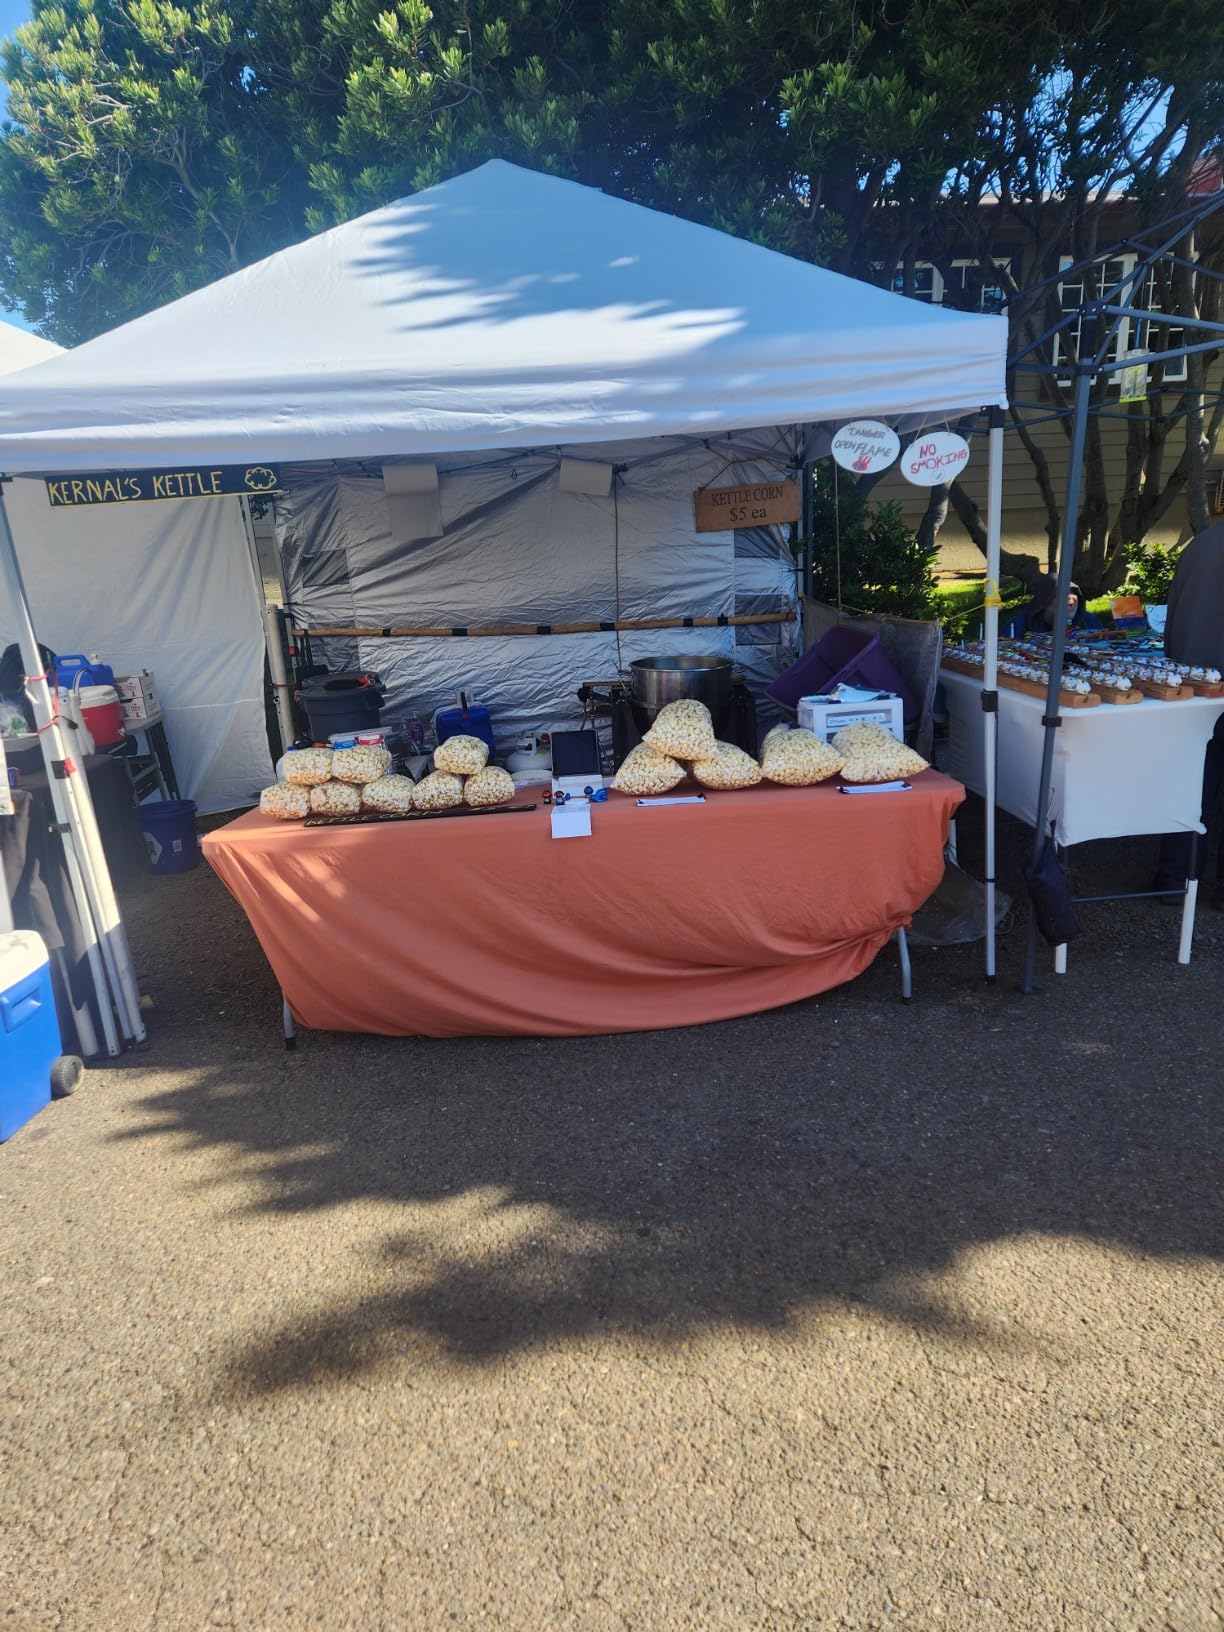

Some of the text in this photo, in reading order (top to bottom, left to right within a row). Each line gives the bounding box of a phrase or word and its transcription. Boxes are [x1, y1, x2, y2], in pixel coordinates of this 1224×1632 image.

[834, 440, 893, 458] OPEN FLAME
[919, 444, 937, 458] NO
[910, 449, 968, 474] SMOKING
[50, 471, 223, 505] KERNAL'S KETTLE
[711, 486, 784, 507] KETTLE CORN
[729, 507, 767, 522] $5 ea
